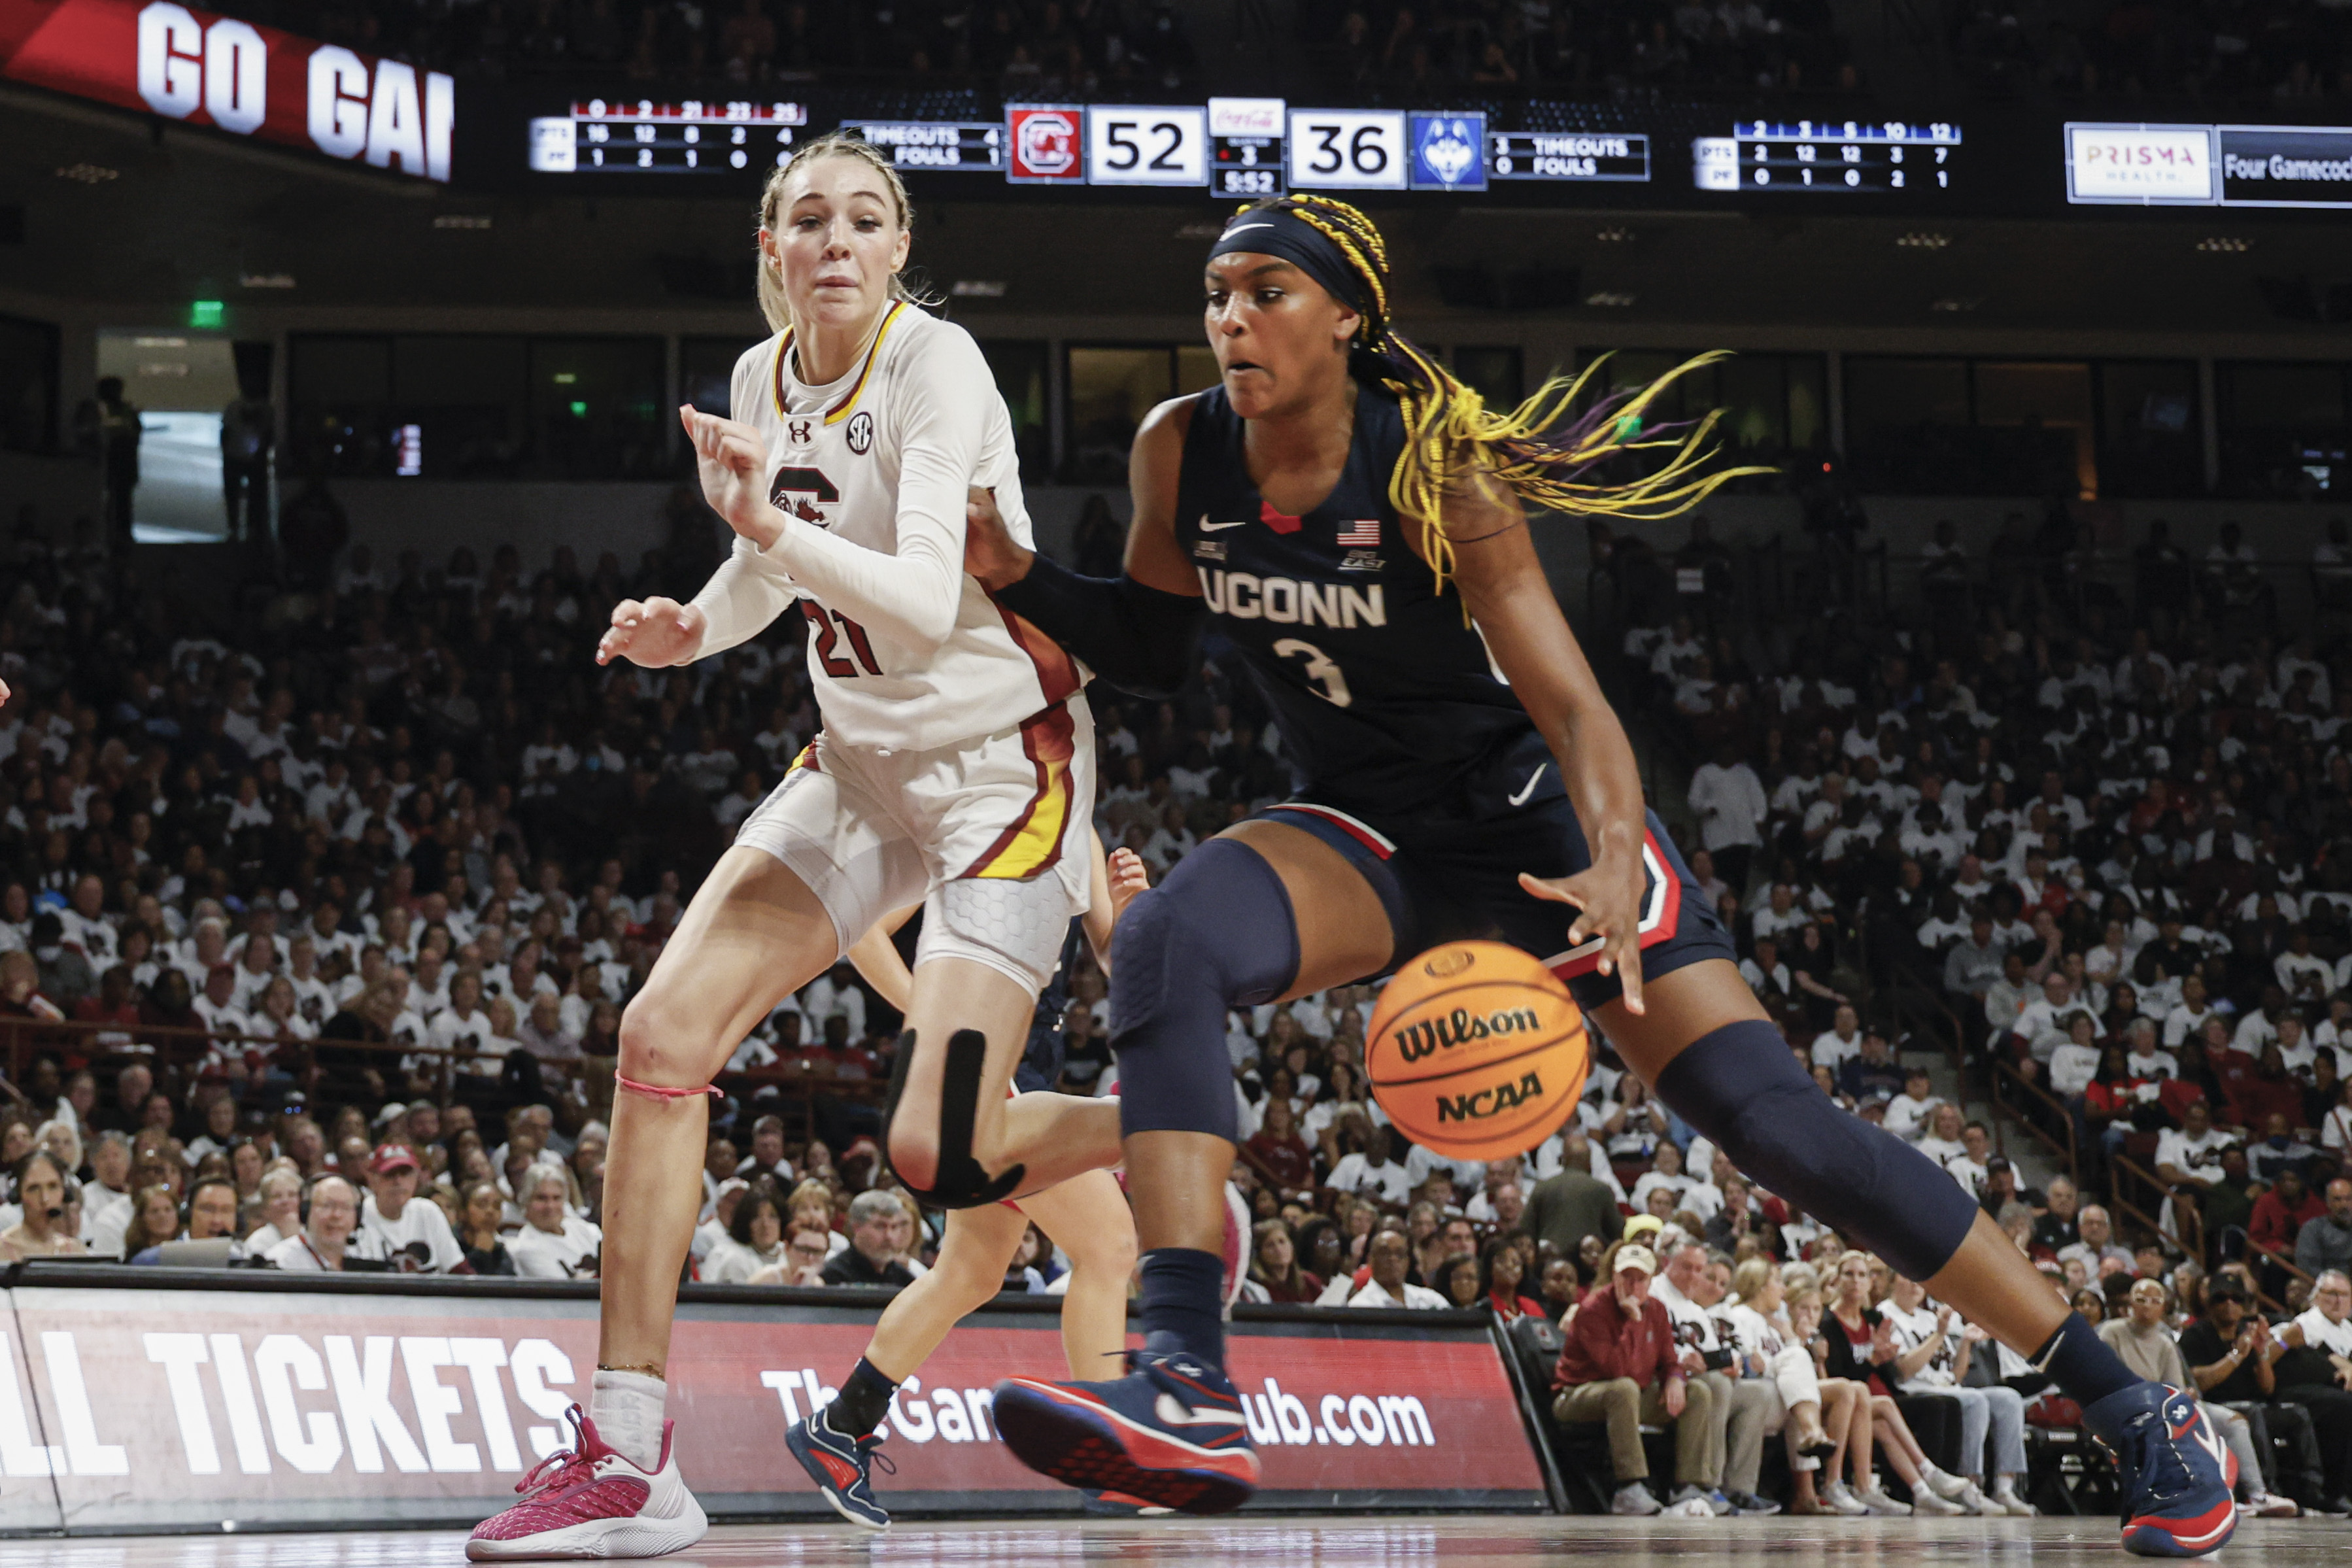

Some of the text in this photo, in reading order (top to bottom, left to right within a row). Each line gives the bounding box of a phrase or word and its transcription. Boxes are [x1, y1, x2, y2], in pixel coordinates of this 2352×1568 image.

[138, 1, 267, 135] GO
[638, 99, 653, 120] 2
[731, 126, 746, 145] 2
[861, 125, 999, 146] TIMEOUTS 4
[1754, 120, 1766, 139] 2
[1884, 122, 1907, 141] 10
[1930, 123, 1952, 141] 12
[894, 146, 1000, 166] FOULS 1
[1106, 122, 1184, 170] 52
[1241, 145, 1257, 166] 3
[1309, 126, 1387, 175] 36
[1496, 137, 1629, 158] 3 TIMEOUTS
[1754, 145, 1768, 162] 2
[1935, 146, 1948, 164] 7
[2087, 146, 2195, 165] PRISMA
[638, 148, 653, 168] 2
[1496, 156, 1598, 177] 0 FOULS
[2224, 153, 2352, 182] Four Gamecoc
[1754, 167, 1771, 186] 0
[1801, 167, 1813, 186] 1
[1844, 168, 1861, 187] 0
[1891, 169, 1905, 188] 2
[1937, 171, 1948, 188] 1
[849, 413, 872, 451] SEC
[1340, 557, 1387, 570] EAST
[1197, 565, 1388, 629] UCONN
[799, 598, 884, 678] 21
[1272, 638, 1352, 708] 3
[1393, 1006, 1541, 1063] Wilson
[1435, 1071, 1544, 1123] NCAA
[143, 1333, 578, 1474] TICKETS
